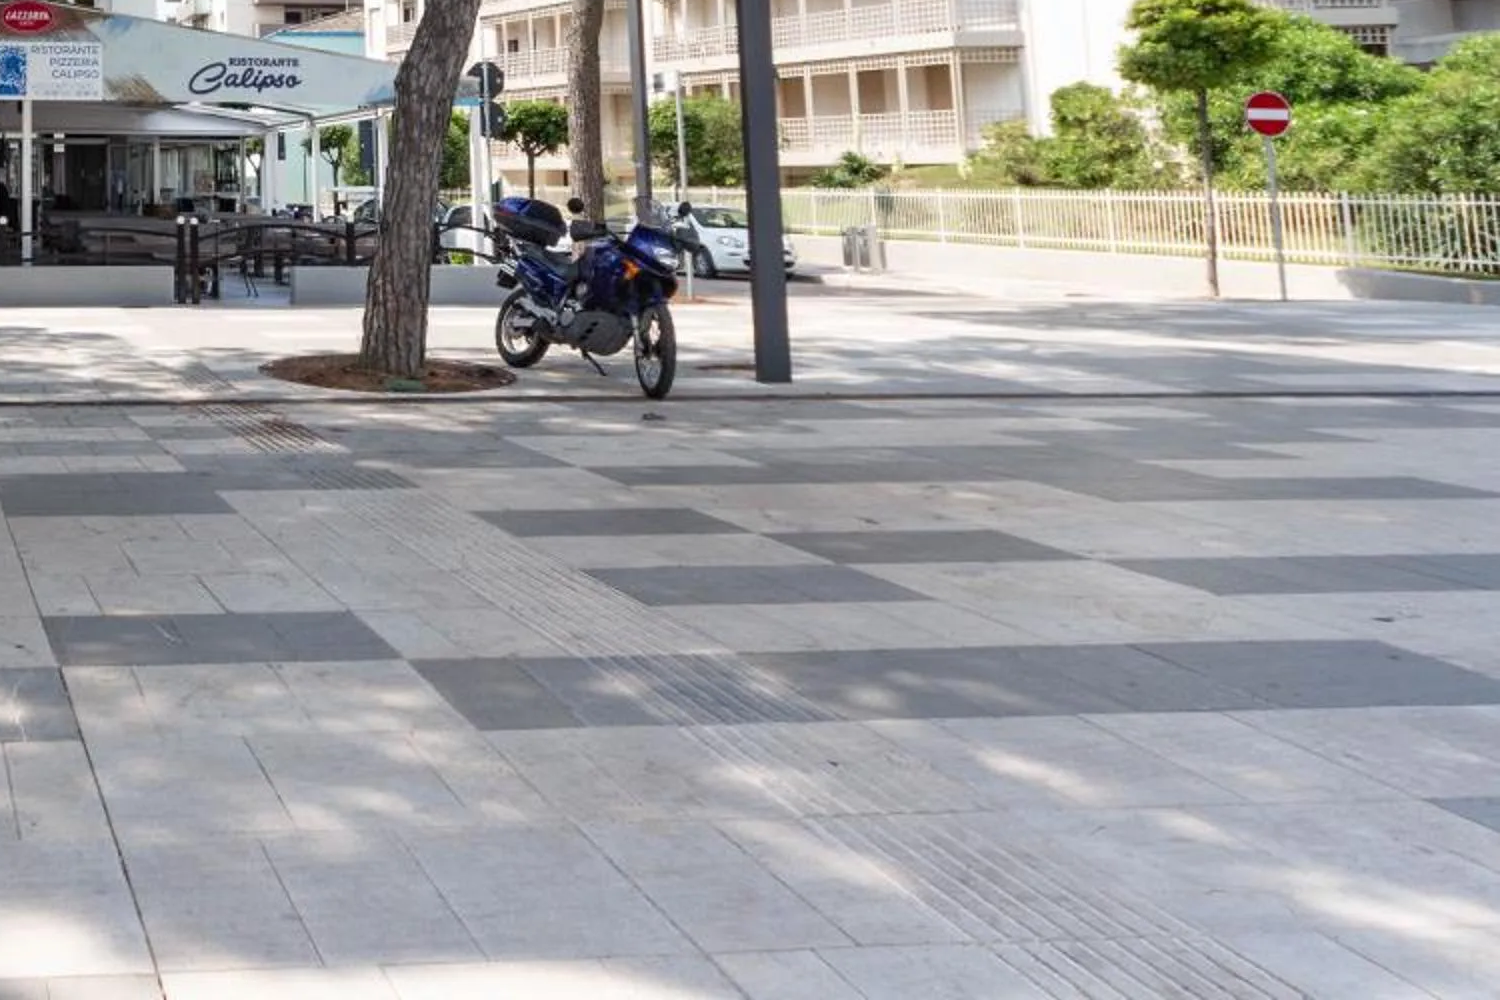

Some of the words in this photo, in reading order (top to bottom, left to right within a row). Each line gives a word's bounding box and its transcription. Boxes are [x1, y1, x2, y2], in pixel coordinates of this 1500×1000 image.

[31, 45, 100, 55] RISTORANTE
[49, 57, 100, 67] PIZZERIA
[228, 57, 300, 67] RISTORANTE
[51, 68, 100, 79] CALIPSO
[188, 62, 302, 95] Calipso
